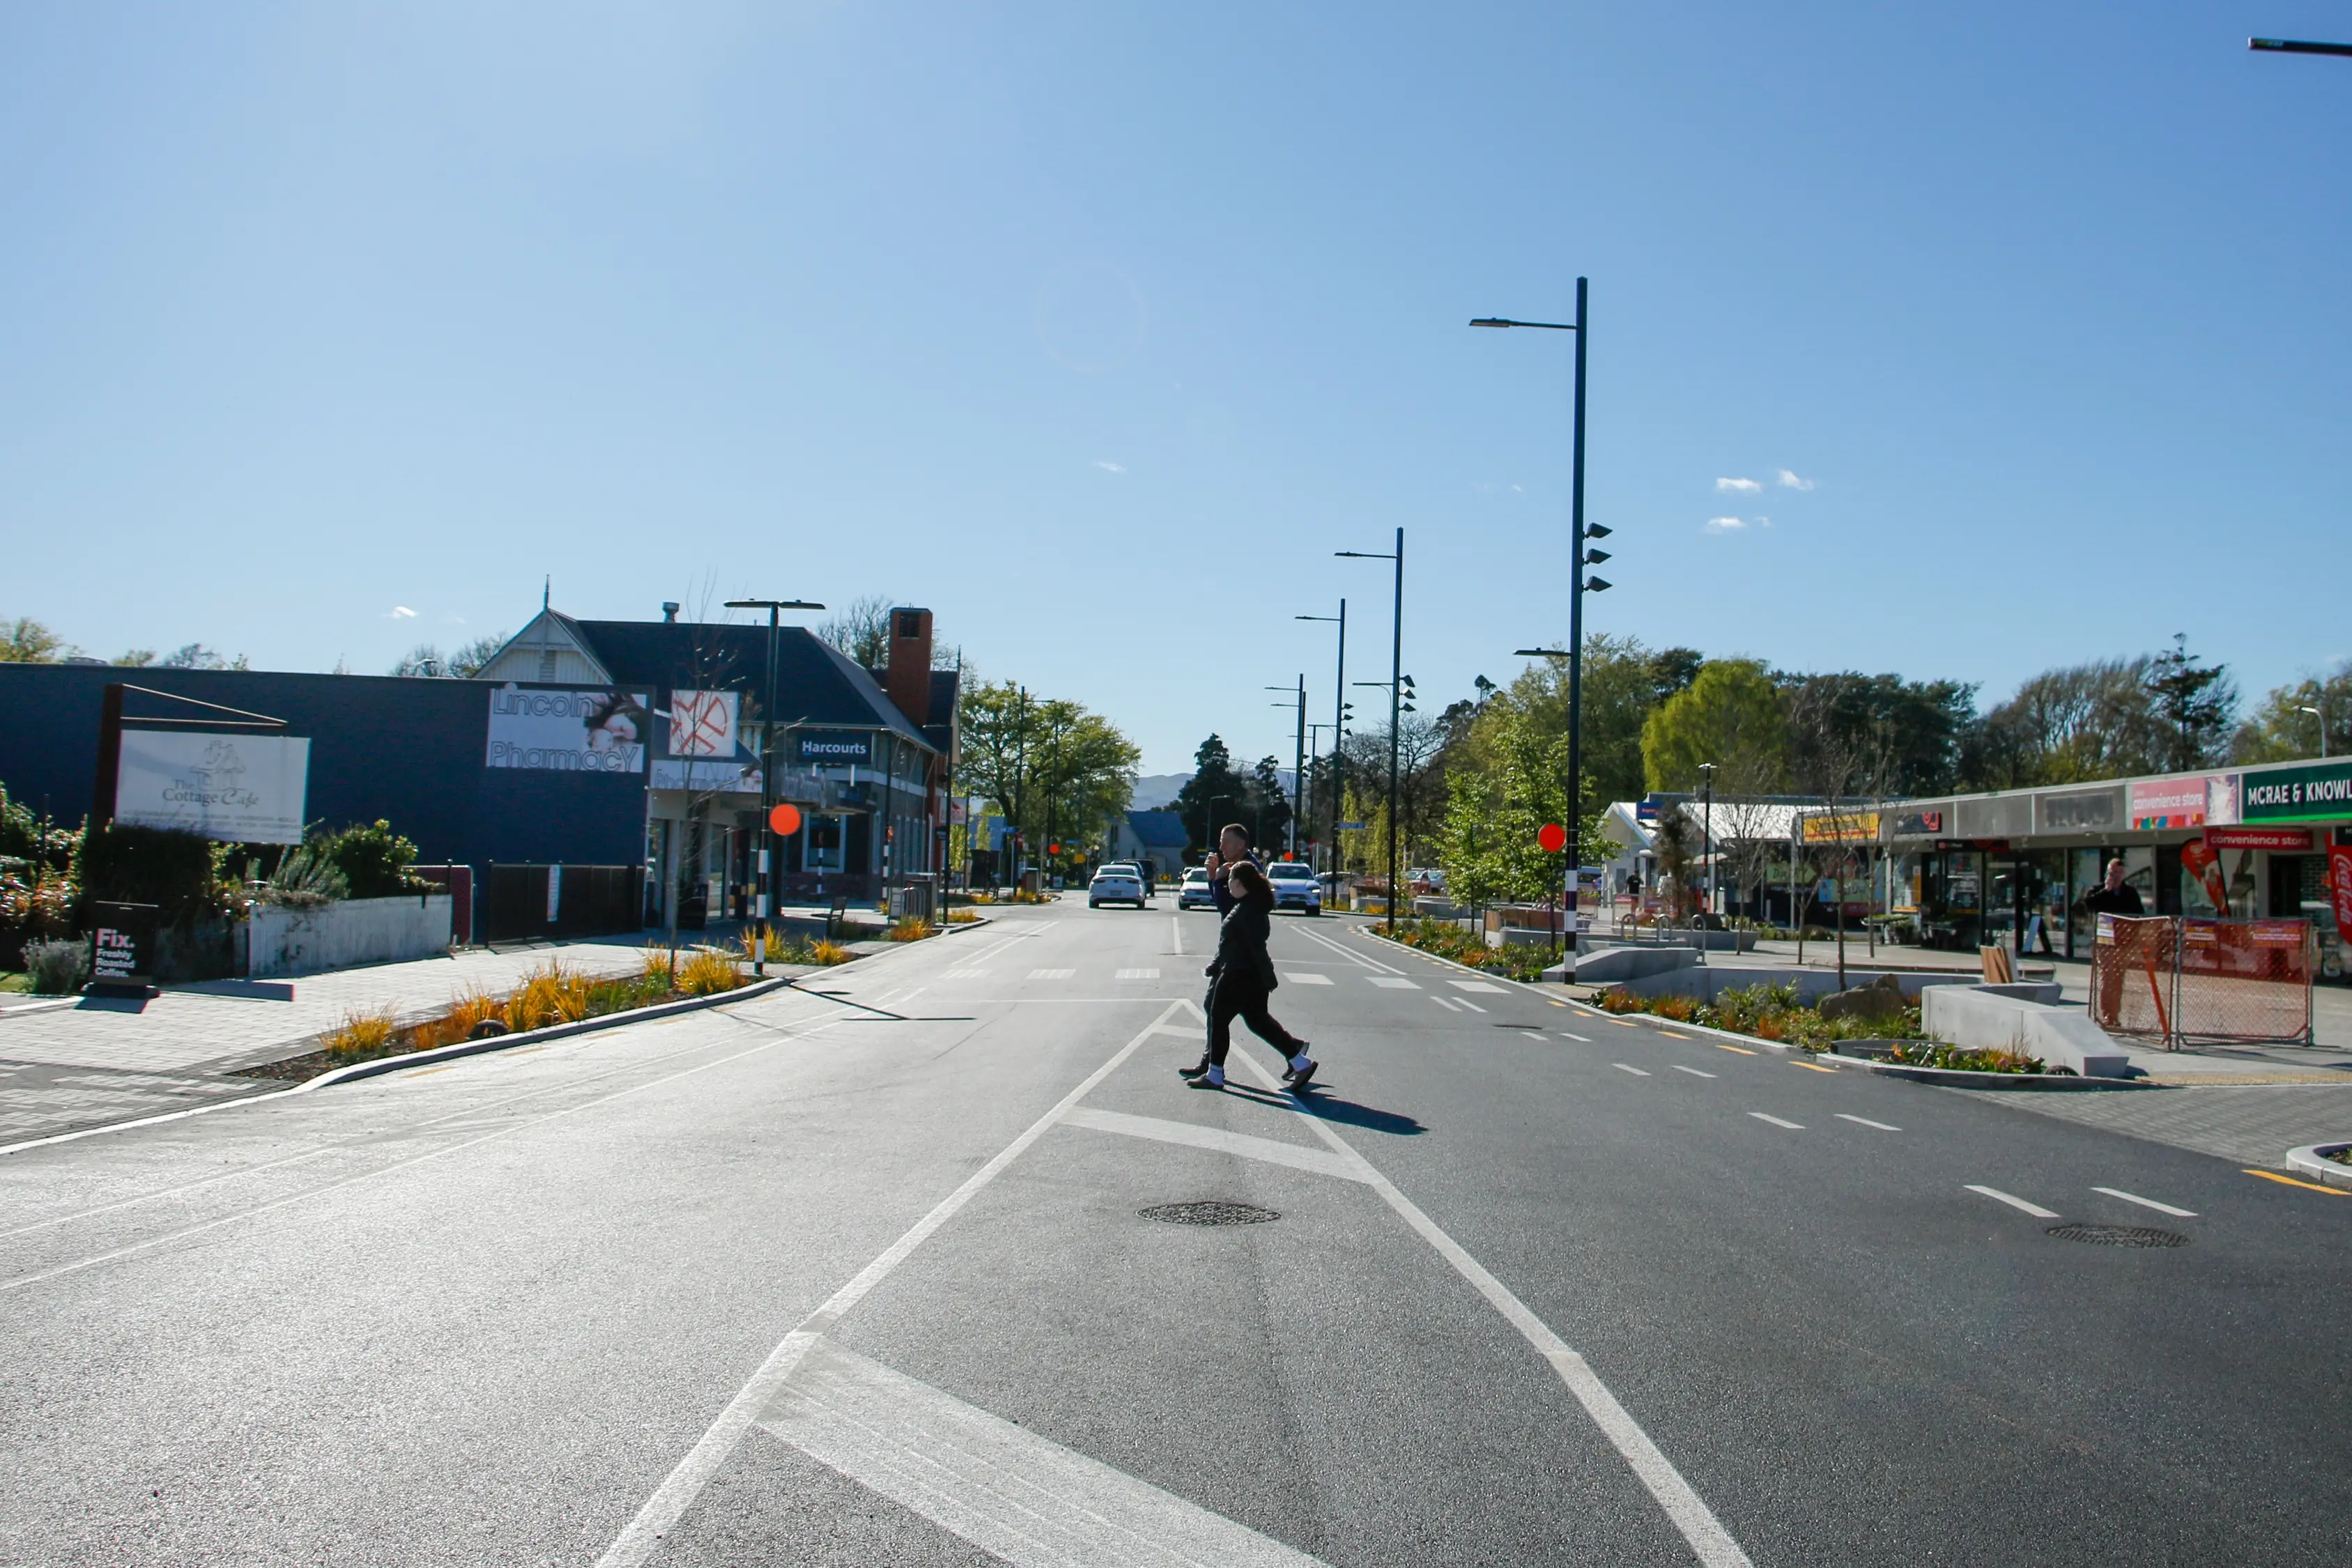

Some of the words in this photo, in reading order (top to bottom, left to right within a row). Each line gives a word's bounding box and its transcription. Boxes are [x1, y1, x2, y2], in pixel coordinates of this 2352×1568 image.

[492, 683, 593, 718] Lincoln
[802, 740, 867, 755] Harcourts
[162, 787, 219, 807] Cottage
[2132, 792, 2181, 810] convenience
[2182, 791, 2204, 807] store
[2247, 785, 2289, 806] MCRAE
[2292, 783, 2303, 802] &
[2306, 779, 2352, 801] KNOWL
[2210, 833, 2279, 845] convenience
[2281, 836, 2309, 845] store
[96, 928, 135, 948] Fix.
[95, 958, 136, 968] Roasted
[96, 948, 132, 960] Freshly
